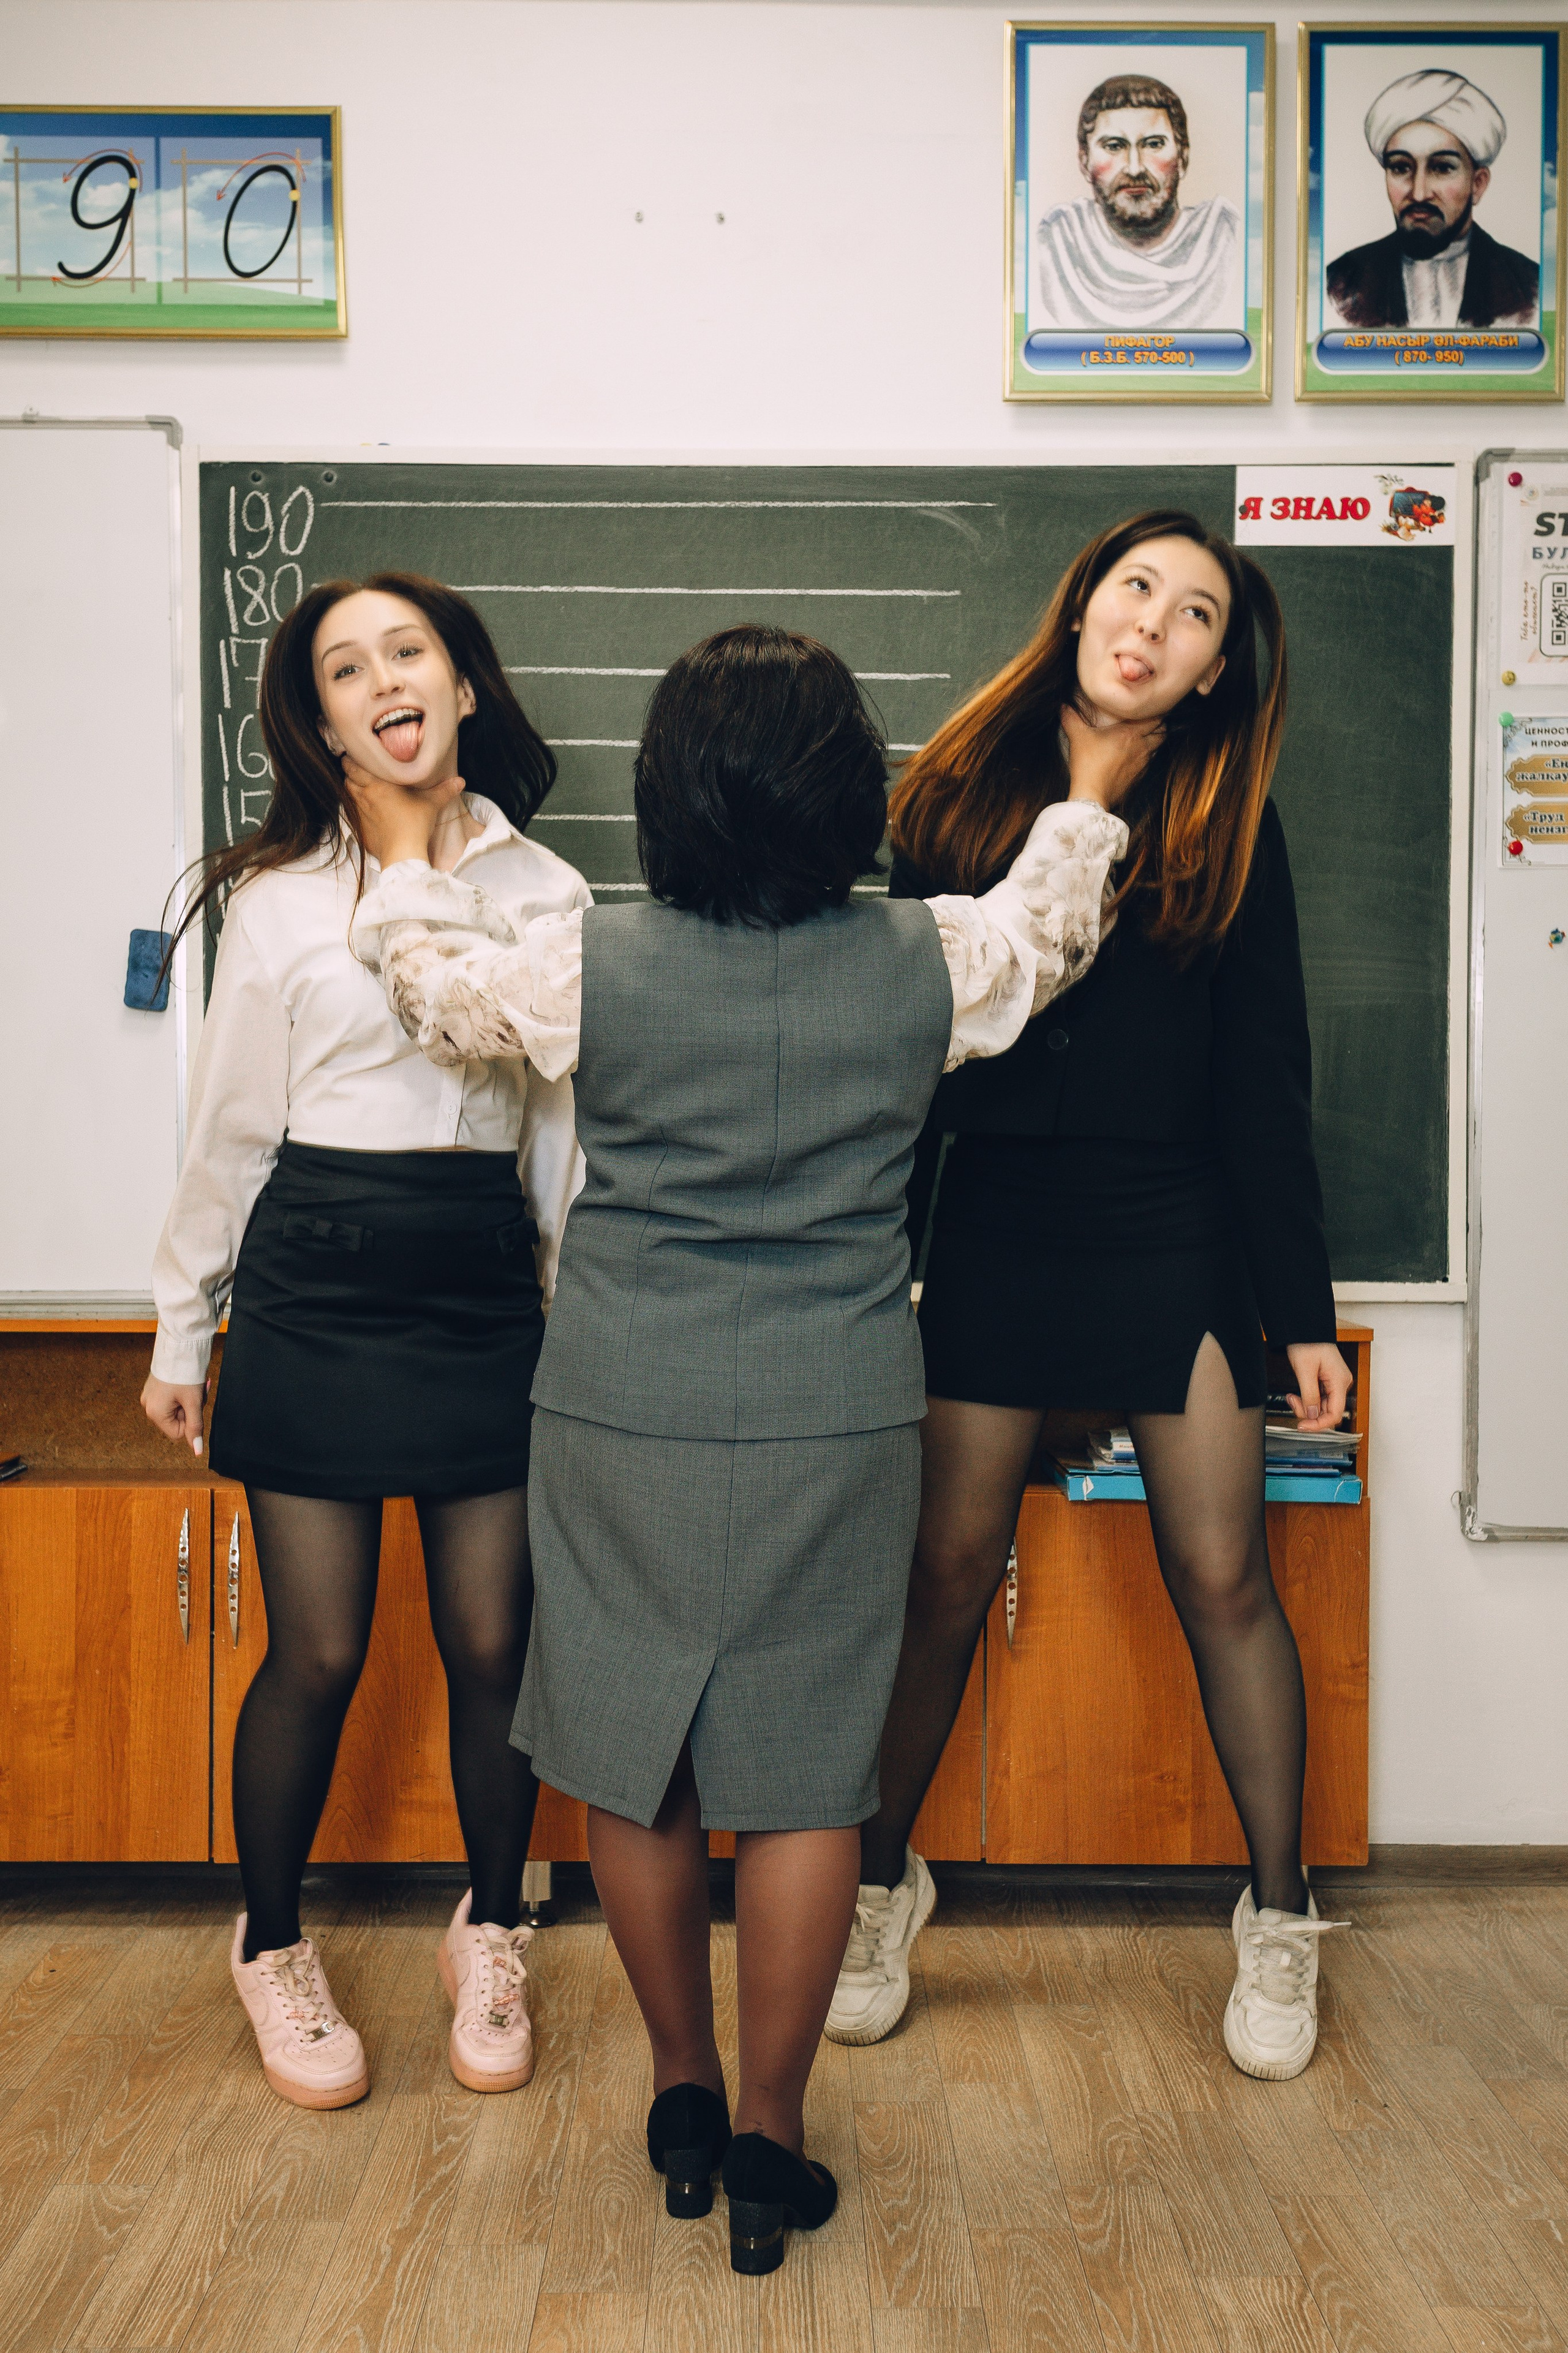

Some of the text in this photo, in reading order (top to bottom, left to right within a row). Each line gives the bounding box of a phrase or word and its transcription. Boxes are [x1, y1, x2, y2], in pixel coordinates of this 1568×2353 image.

[58, 154, 300, 279] 9 0
[1104, 335, 1175, 348] ПИФАГОР
[1344, 335, 1374, 347] АБУ
[1376, 335, 1430, 347] НАСЫР
[229, 486, 314, 559] 190
[1238, 497, 1371, 520] Я ЗНАЮ
[224, 563, 303, 634] 180
[218, 713, 275, 782] 16
